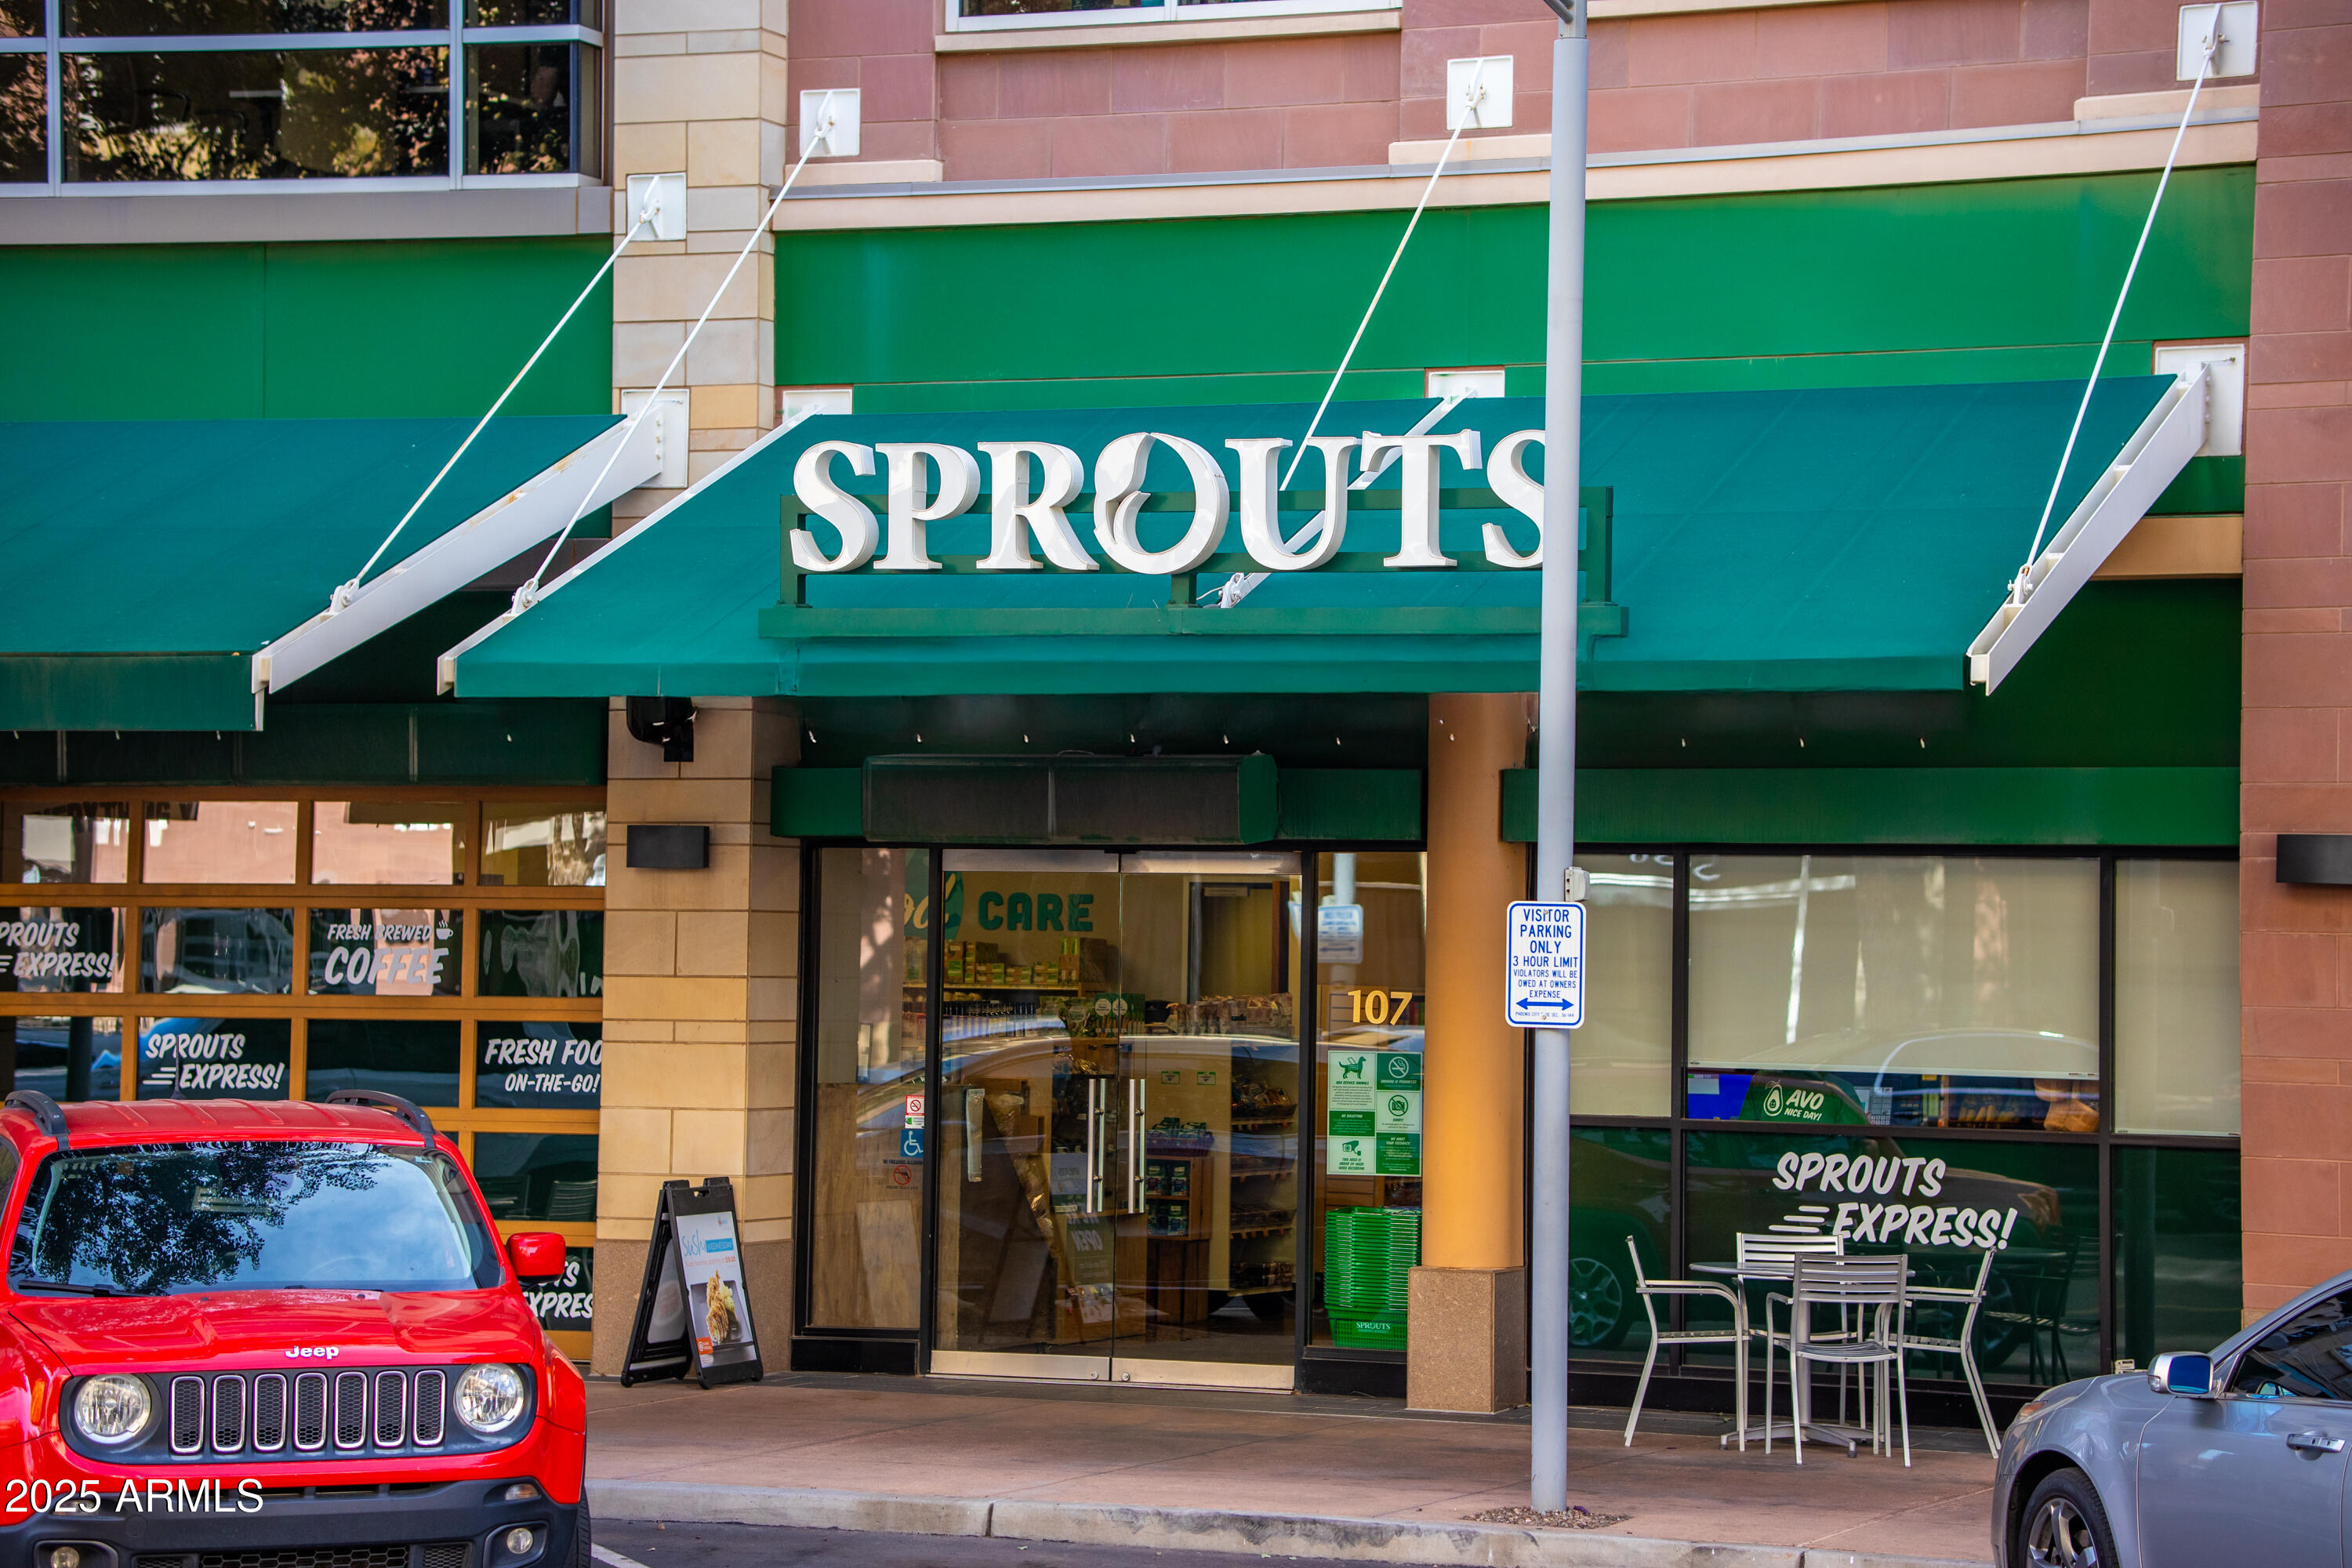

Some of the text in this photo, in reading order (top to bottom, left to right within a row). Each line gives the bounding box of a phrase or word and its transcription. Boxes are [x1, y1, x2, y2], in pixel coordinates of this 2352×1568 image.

[790, 430, 1544, 575] SPROUTS
[978, 891, 1094, 931] CARE
[1523, 909, 1570, 922] VISITOR
[327, 924, 433, 941] FRESH BREWED
[1520, 924, 1572, 938] PARKING
[1530, 940, 1561, 953] ONLY
[13, 952, 119, 978] EXPRESS!
[325, 946, 449, 985] COFFEE
[1513, 956, 1578, 968] 3 HOUR LIMIT
[1513, 969, 1549, 978] VIOLATORS
[1570, 970, 1578, 978] BE
[1530, 989, 1561, 998] EXPENSE
[1539, 979, 1547, 988] AT
[1550, 980, 1577, 989] OWNERS
[1348, 990, 1413, 1025] 107
[145, 1033, 246, 1058] SPROUTS
[485, 1039, 557, 1065] FRESH
[179, 1062, 285, 1090] EXPRESS!
[505, 1073, 601, 1093] ON-THE-GO!
[1785, 1089, 1824, 1110] AVO
[1784, 1107, 1823, 1121] NICE DAY!
[1772, 1152, 1947, 1197] SPROUTS
[1832, 1202, 2018, 1250] EXPRESS!
[1356, 1321, 1390, 1330] SPROUTS
[285, 1345, 339, 1359] Jeep
